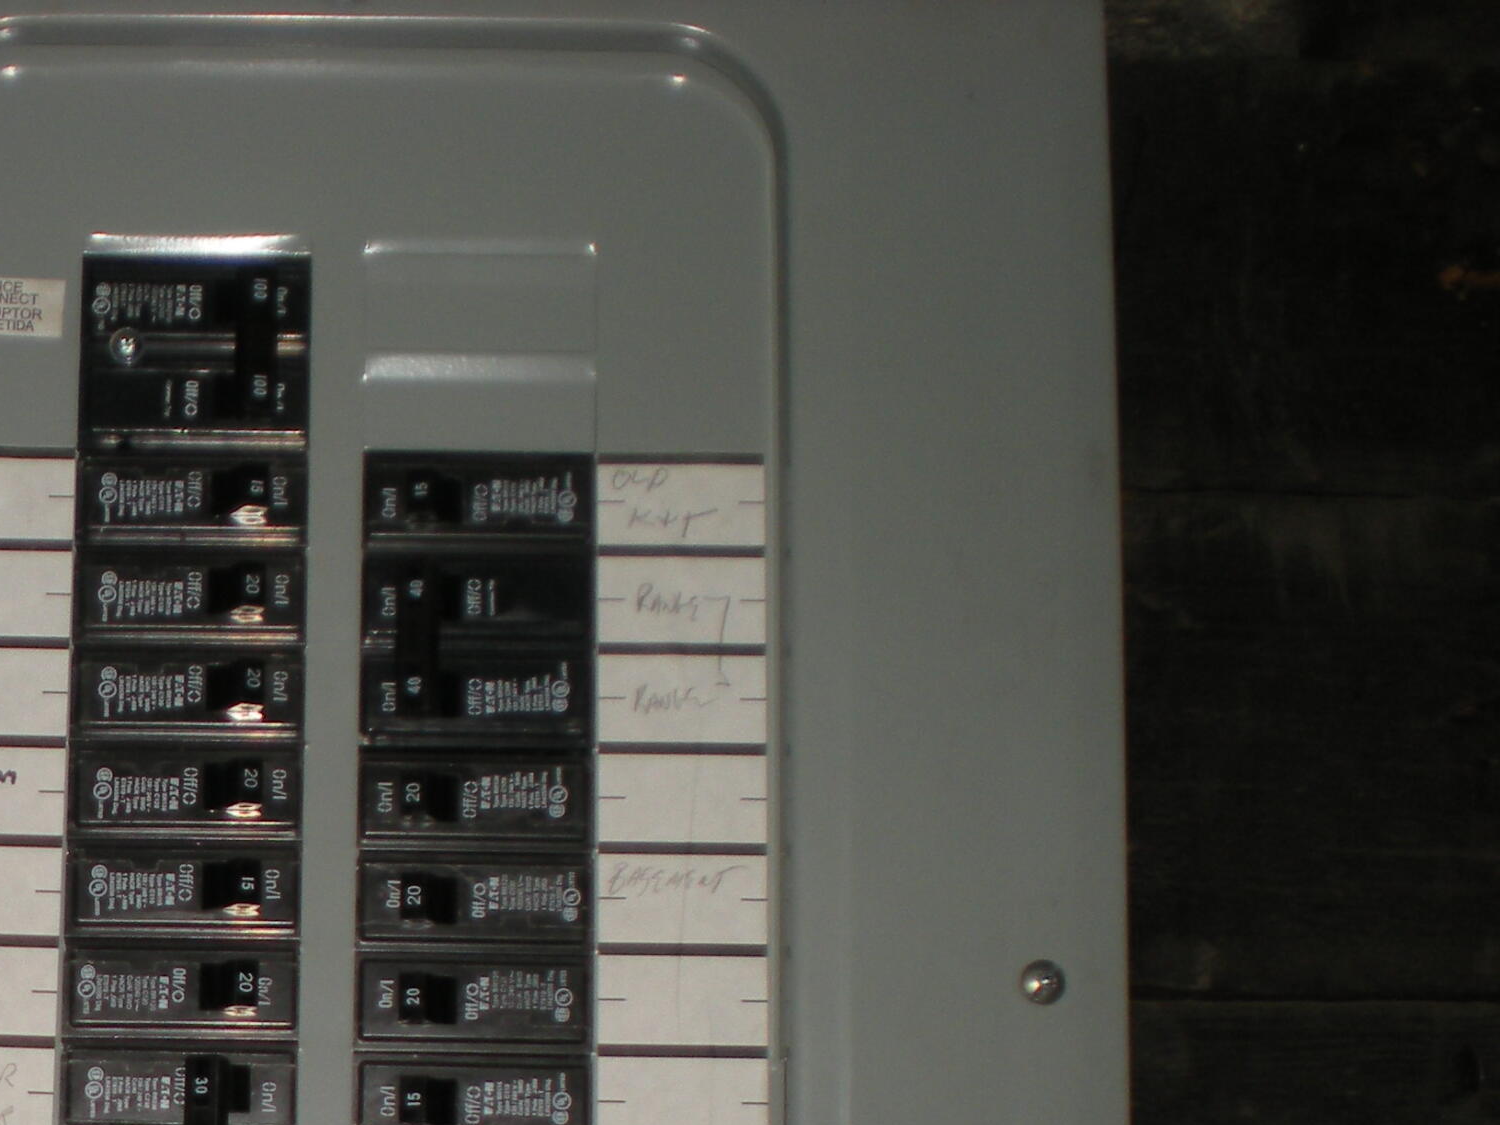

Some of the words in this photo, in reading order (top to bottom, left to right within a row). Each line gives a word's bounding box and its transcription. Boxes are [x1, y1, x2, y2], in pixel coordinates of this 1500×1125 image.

[250, 479, 265, 495] 15
[414, 481, 429, 497] 15
[244, 573, 261, 595] 20
[245, 667, 261, 689] 20
[243, 767, 259, 789] 20
[405, 782, 421, 803] 20
[241, 875, 256, 891] 15
[406, 885, 422, 906] 20
[238, 972, 254, 993] 20
[406, 987, 421, 1006] 20
[194, 1076, 209, 1095] 30
[406, 1091, 422, 1107] 15
